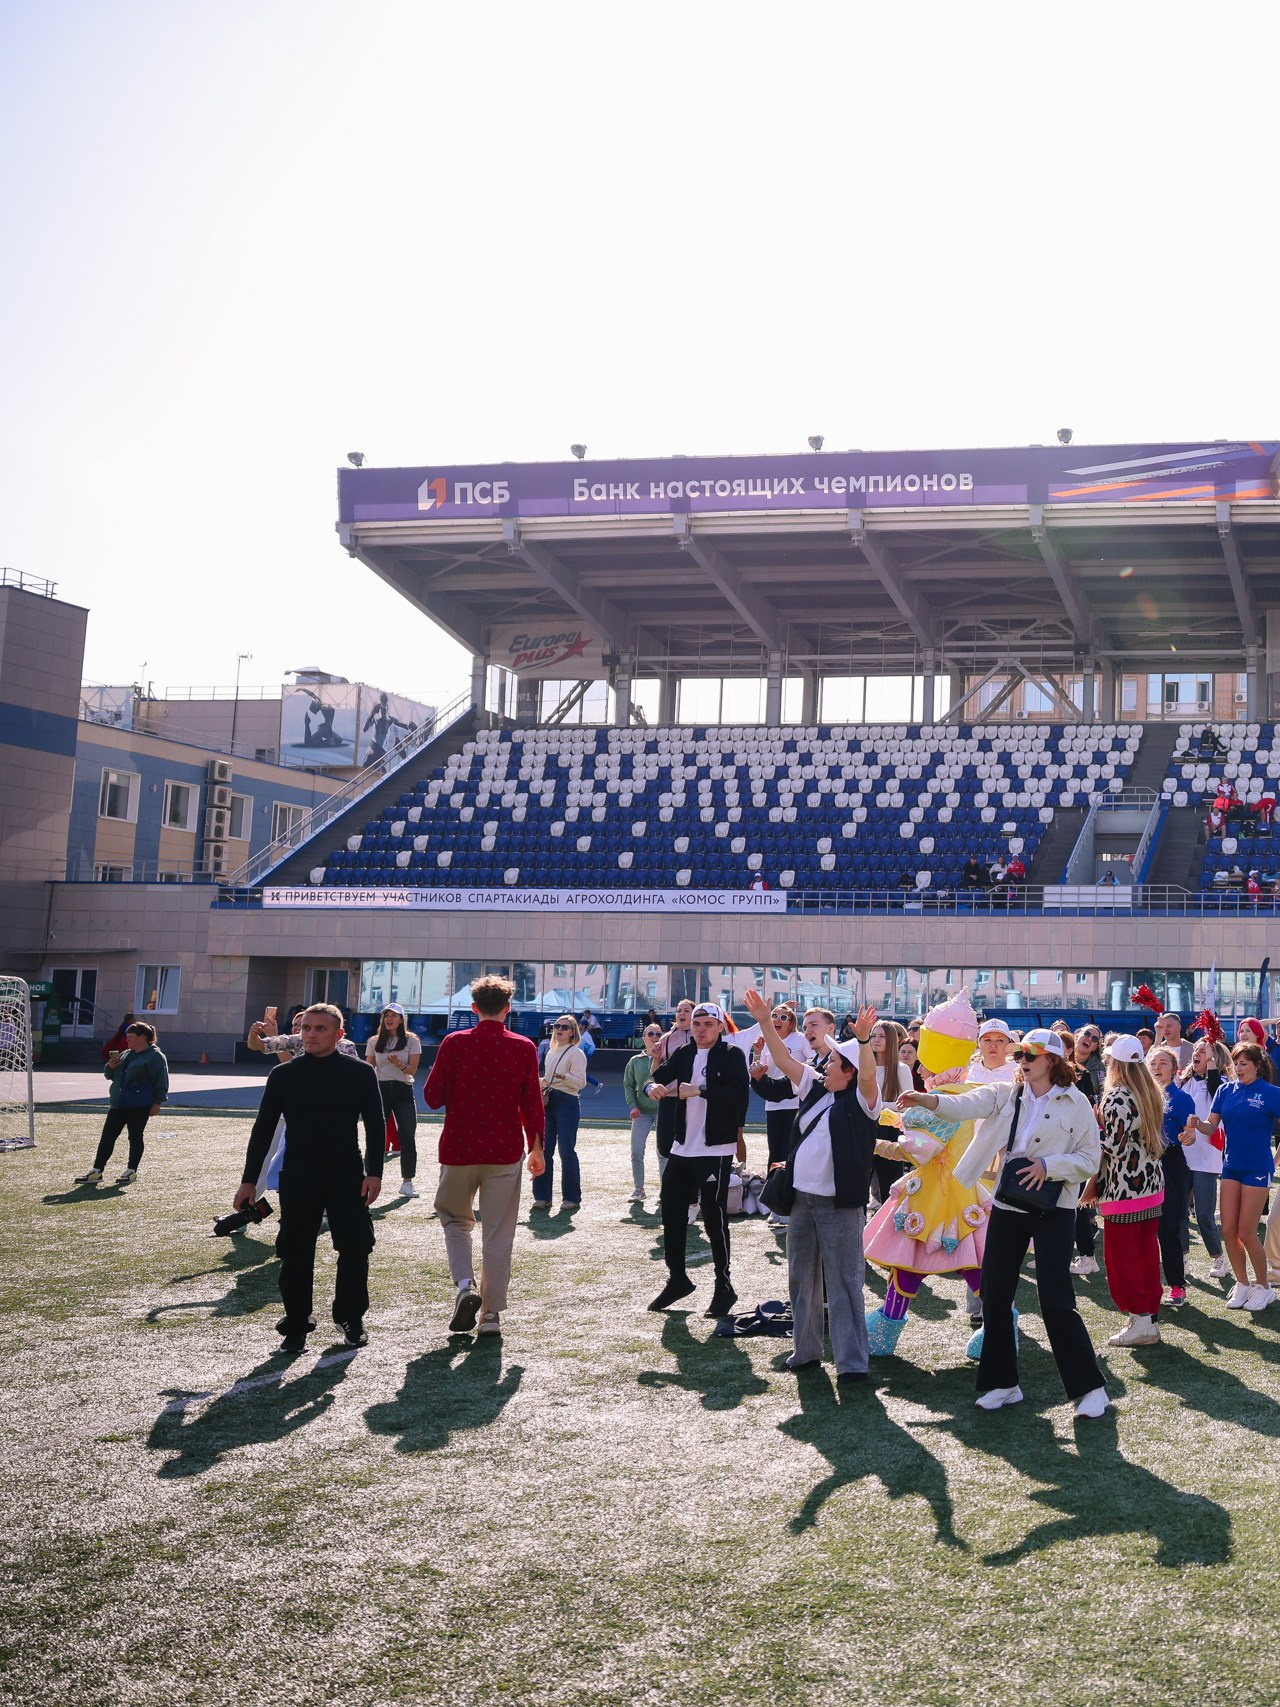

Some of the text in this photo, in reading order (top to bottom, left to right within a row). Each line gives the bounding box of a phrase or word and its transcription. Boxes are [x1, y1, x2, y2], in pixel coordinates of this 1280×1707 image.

[454, 481, 510, 505] ПСБ
[573, 472, 974, 502] Банк настоящих чемпионов
[285, 892, 780, 905] ПРИВЕТСТВУЕМ УЧАСТНИКОВ СПАРТАКИАДЫ АГРОХОЛДИНГА «КОМОС ГРУПП»
